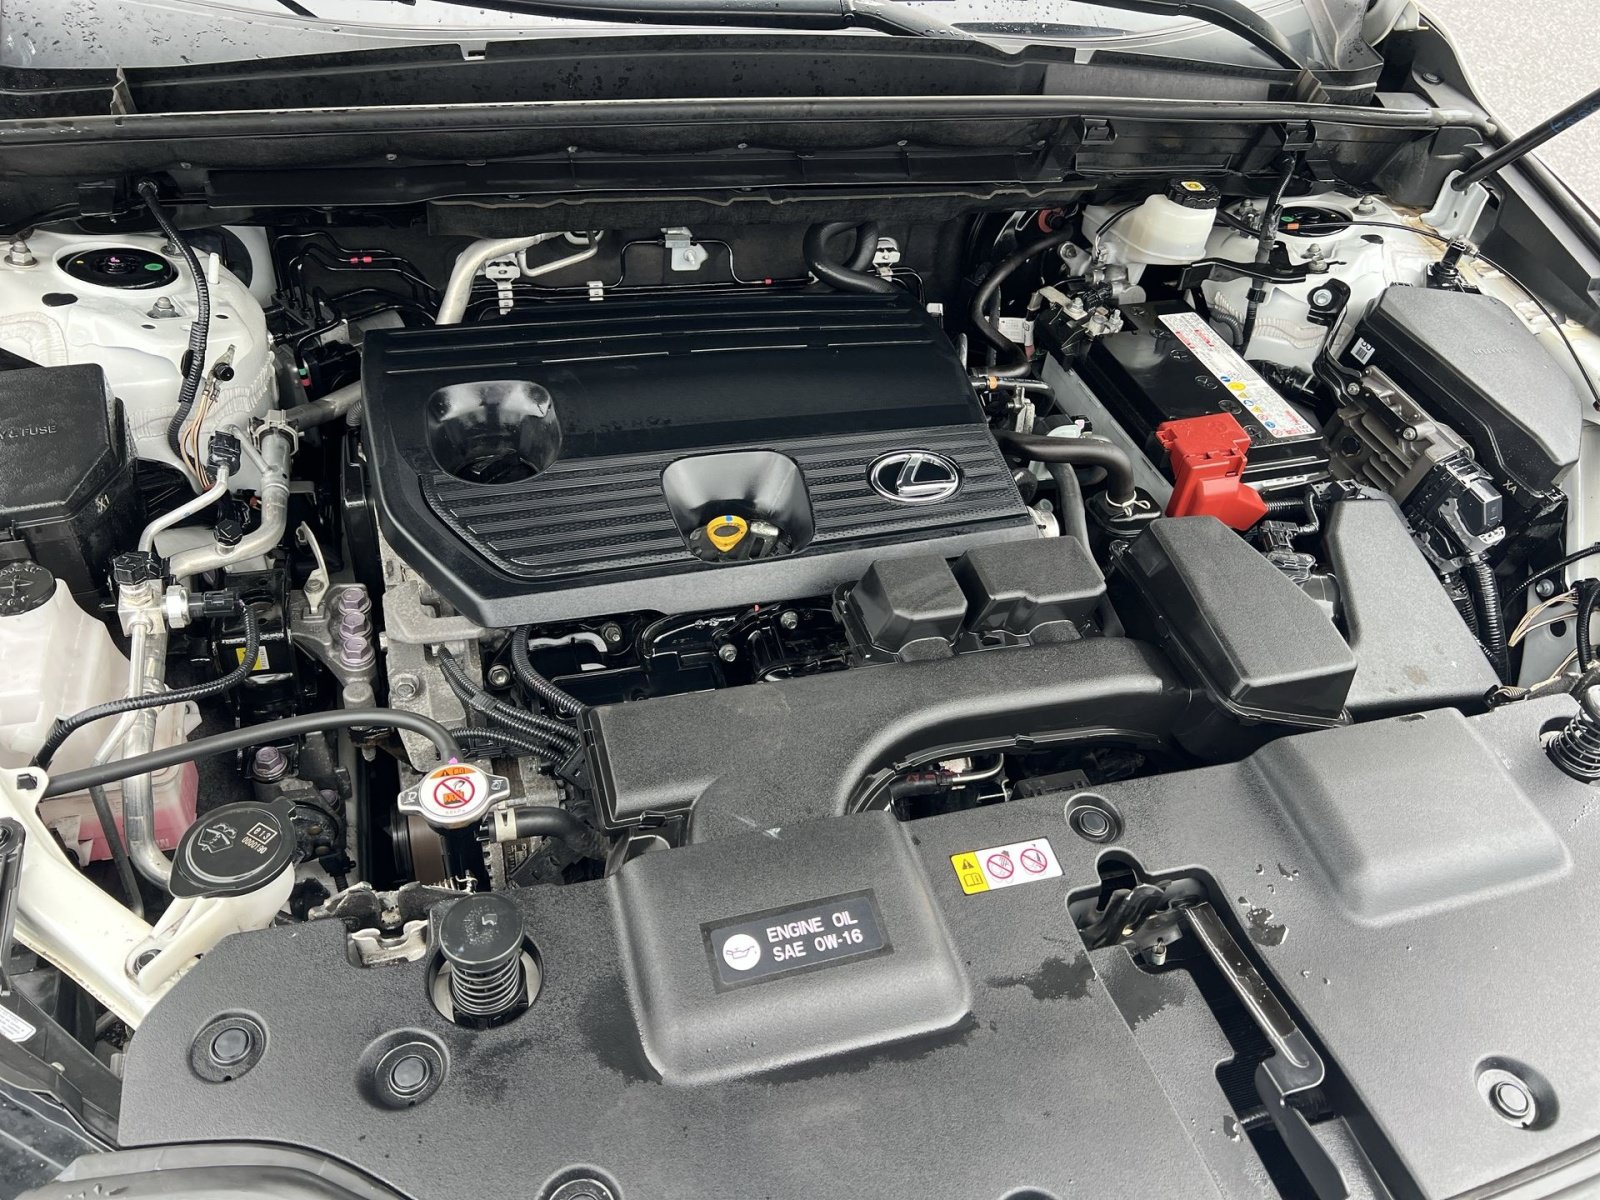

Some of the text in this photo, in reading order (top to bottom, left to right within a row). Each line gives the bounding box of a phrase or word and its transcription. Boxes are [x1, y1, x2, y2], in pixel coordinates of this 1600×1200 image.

[21, 425, 57, 437] FUSE
[1502, 479, 1518, 495] XA
[766, 910, 859, 943] ENGINE OIL
[773, 928, 864, 962] SAE 0W-16
